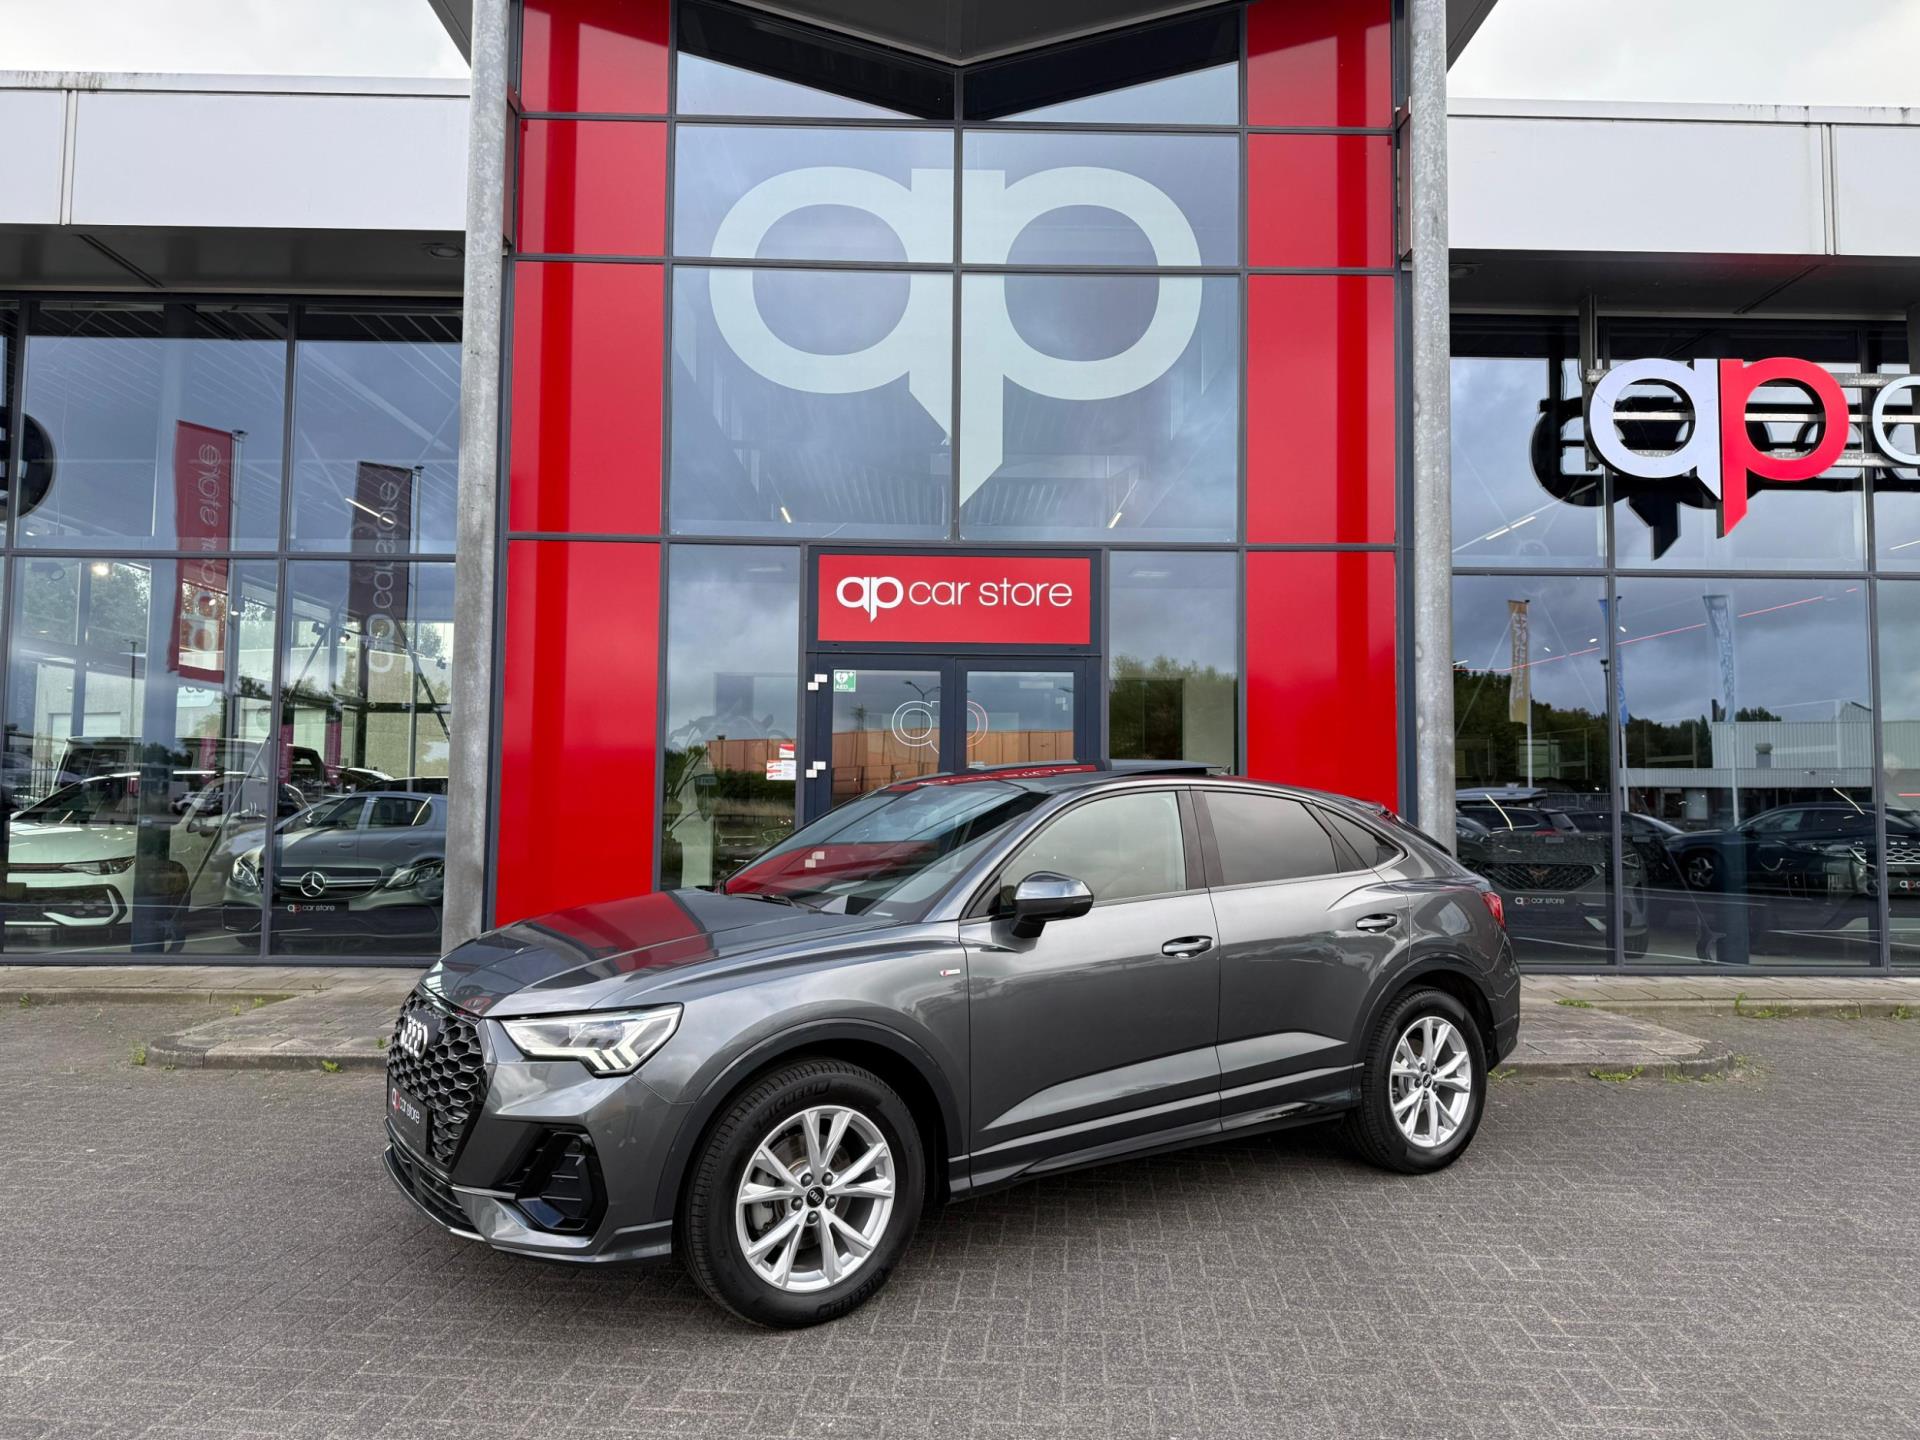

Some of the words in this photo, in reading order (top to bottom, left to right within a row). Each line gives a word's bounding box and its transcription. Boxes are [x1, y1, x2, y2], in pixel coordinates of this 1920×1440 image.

[1589, 356, 1849, 537] ap
[836, 576, 904, 622] ap
[909, 581, 971, 606] car
[979, 577, 1072, 607] store
